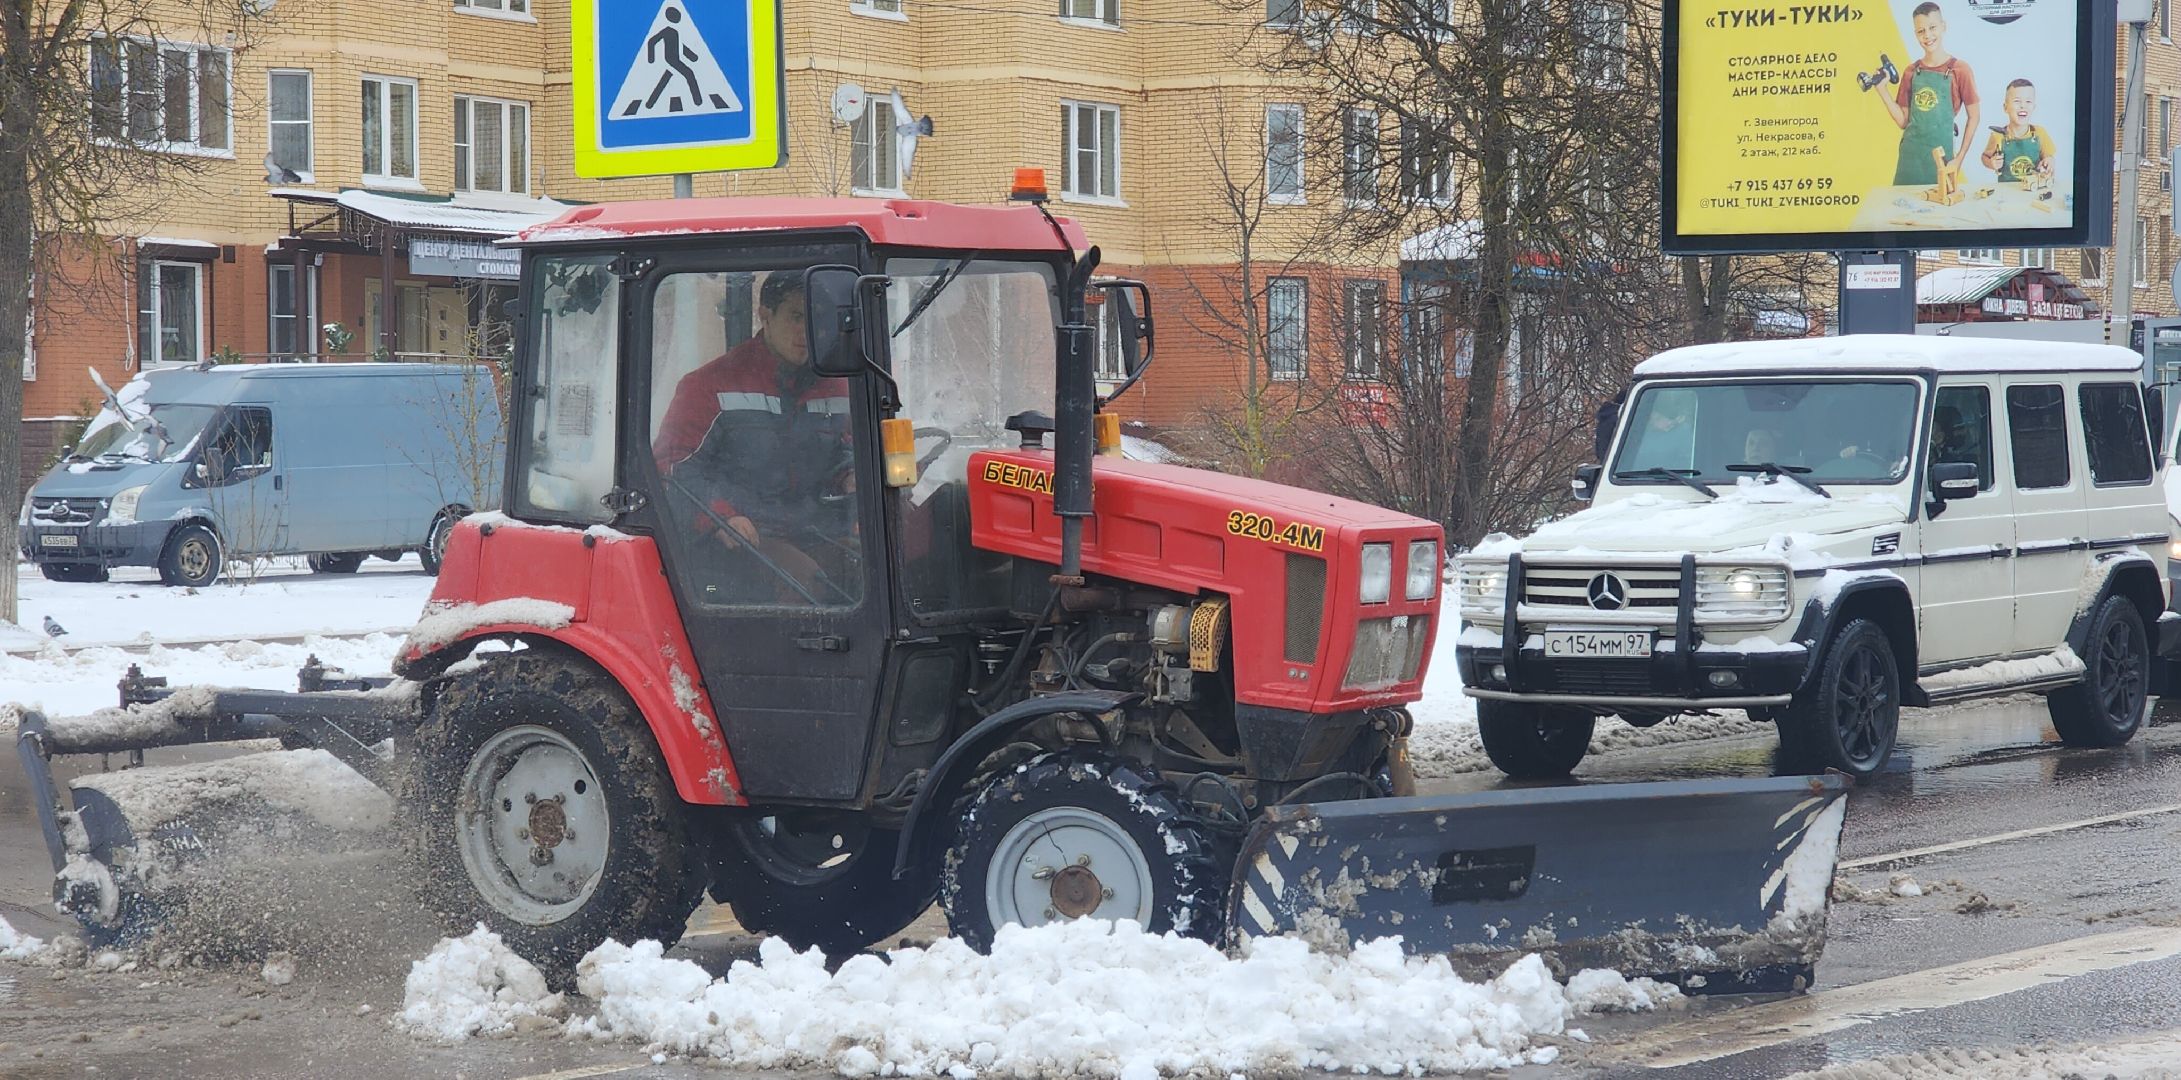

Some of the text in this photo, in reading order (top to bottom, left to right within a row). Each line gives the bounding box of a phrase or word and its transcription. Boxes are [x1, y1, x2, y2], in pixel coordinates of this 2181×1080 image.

[1706, 4, 1863, 29] «ТУКИ-ТУКИ»
[1728, 52, 1838, 67] СТОЛЯРНОЕ ДЕЛО
[1728, 68, 1837, 82] МАСТЕР-КЛАССЫ
[1732, 83, 1831, 97] ДНИ РОЖДЕНИЯ
[1744, 117, 1819, 127] г. Звенигород
[1737, 131, 1825, 144] ул. Некрасова, 6
[1741, 146, 1821, 158] 2 этаж, 212 каб.
[1727, 177, 1833, 191] +7 915 437 69 59
[1700, 194, 1860, 209] @TUKI_TUKI_ZVENIGOROD
[413, 242, 520, 261] ЦЕНТР ДЕНТАЛЬНОЙ
[1985, 297, 2003, 313] ОКНА
[2032, 301, 2052, 317] БАЗА
[1228, 510, 1325, 552] 320.4М
[1627, 634, 1645, 650] 97
